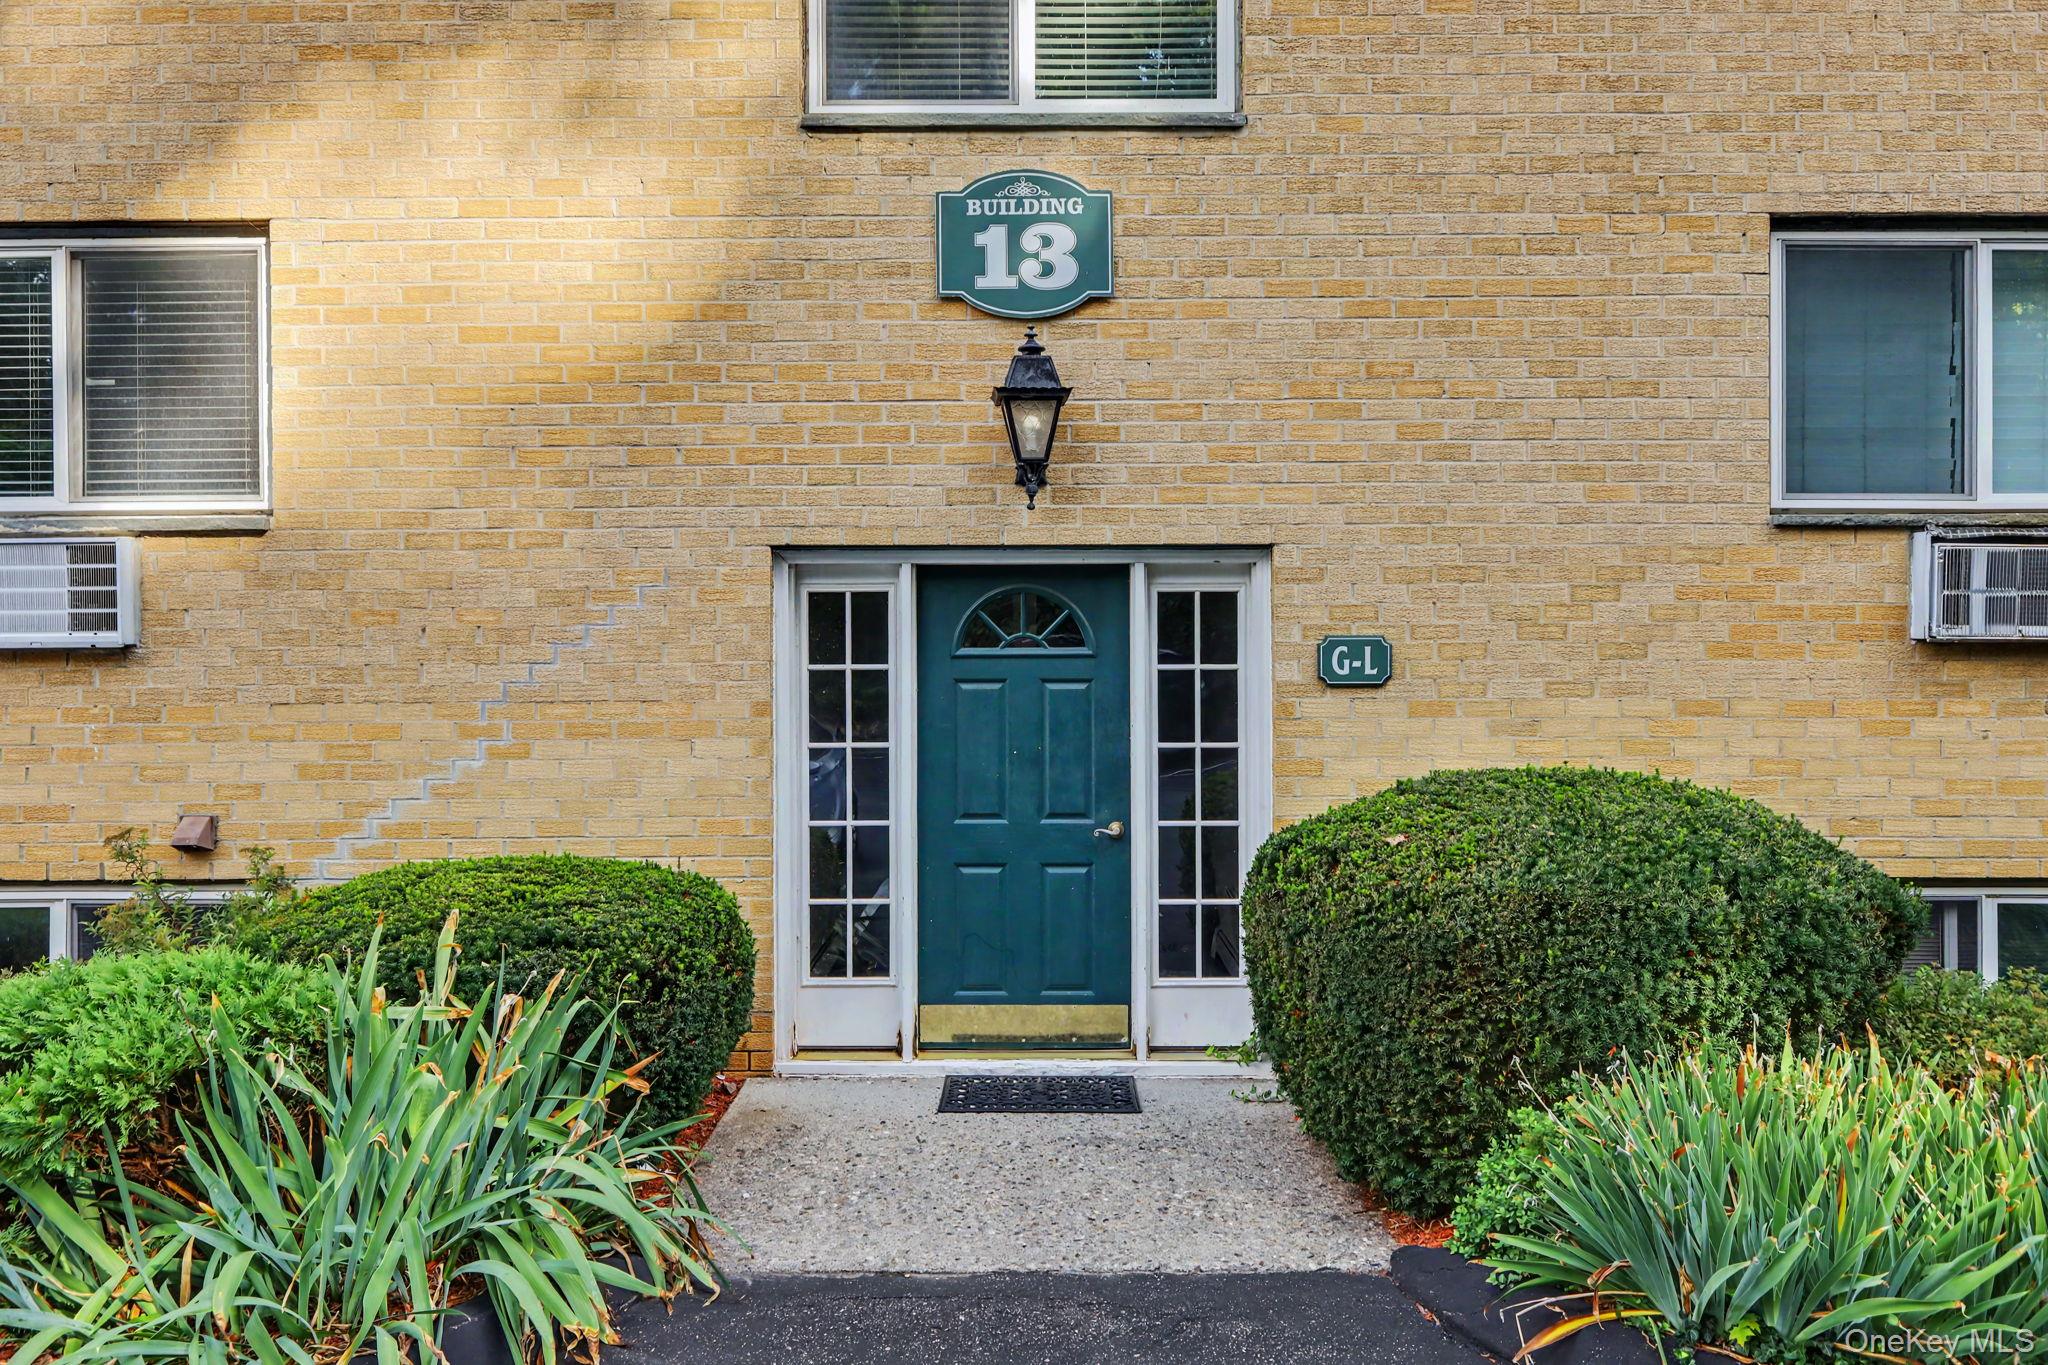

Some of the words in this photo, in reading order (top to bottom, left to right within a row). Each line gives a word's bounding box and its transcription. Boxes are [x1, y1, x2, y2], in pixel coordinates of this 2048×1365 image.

[966, 197, 1084, 216] BUILDING
[974, 222, 1079, 290] 13
[1331, 645, 1378, 675] G-L
